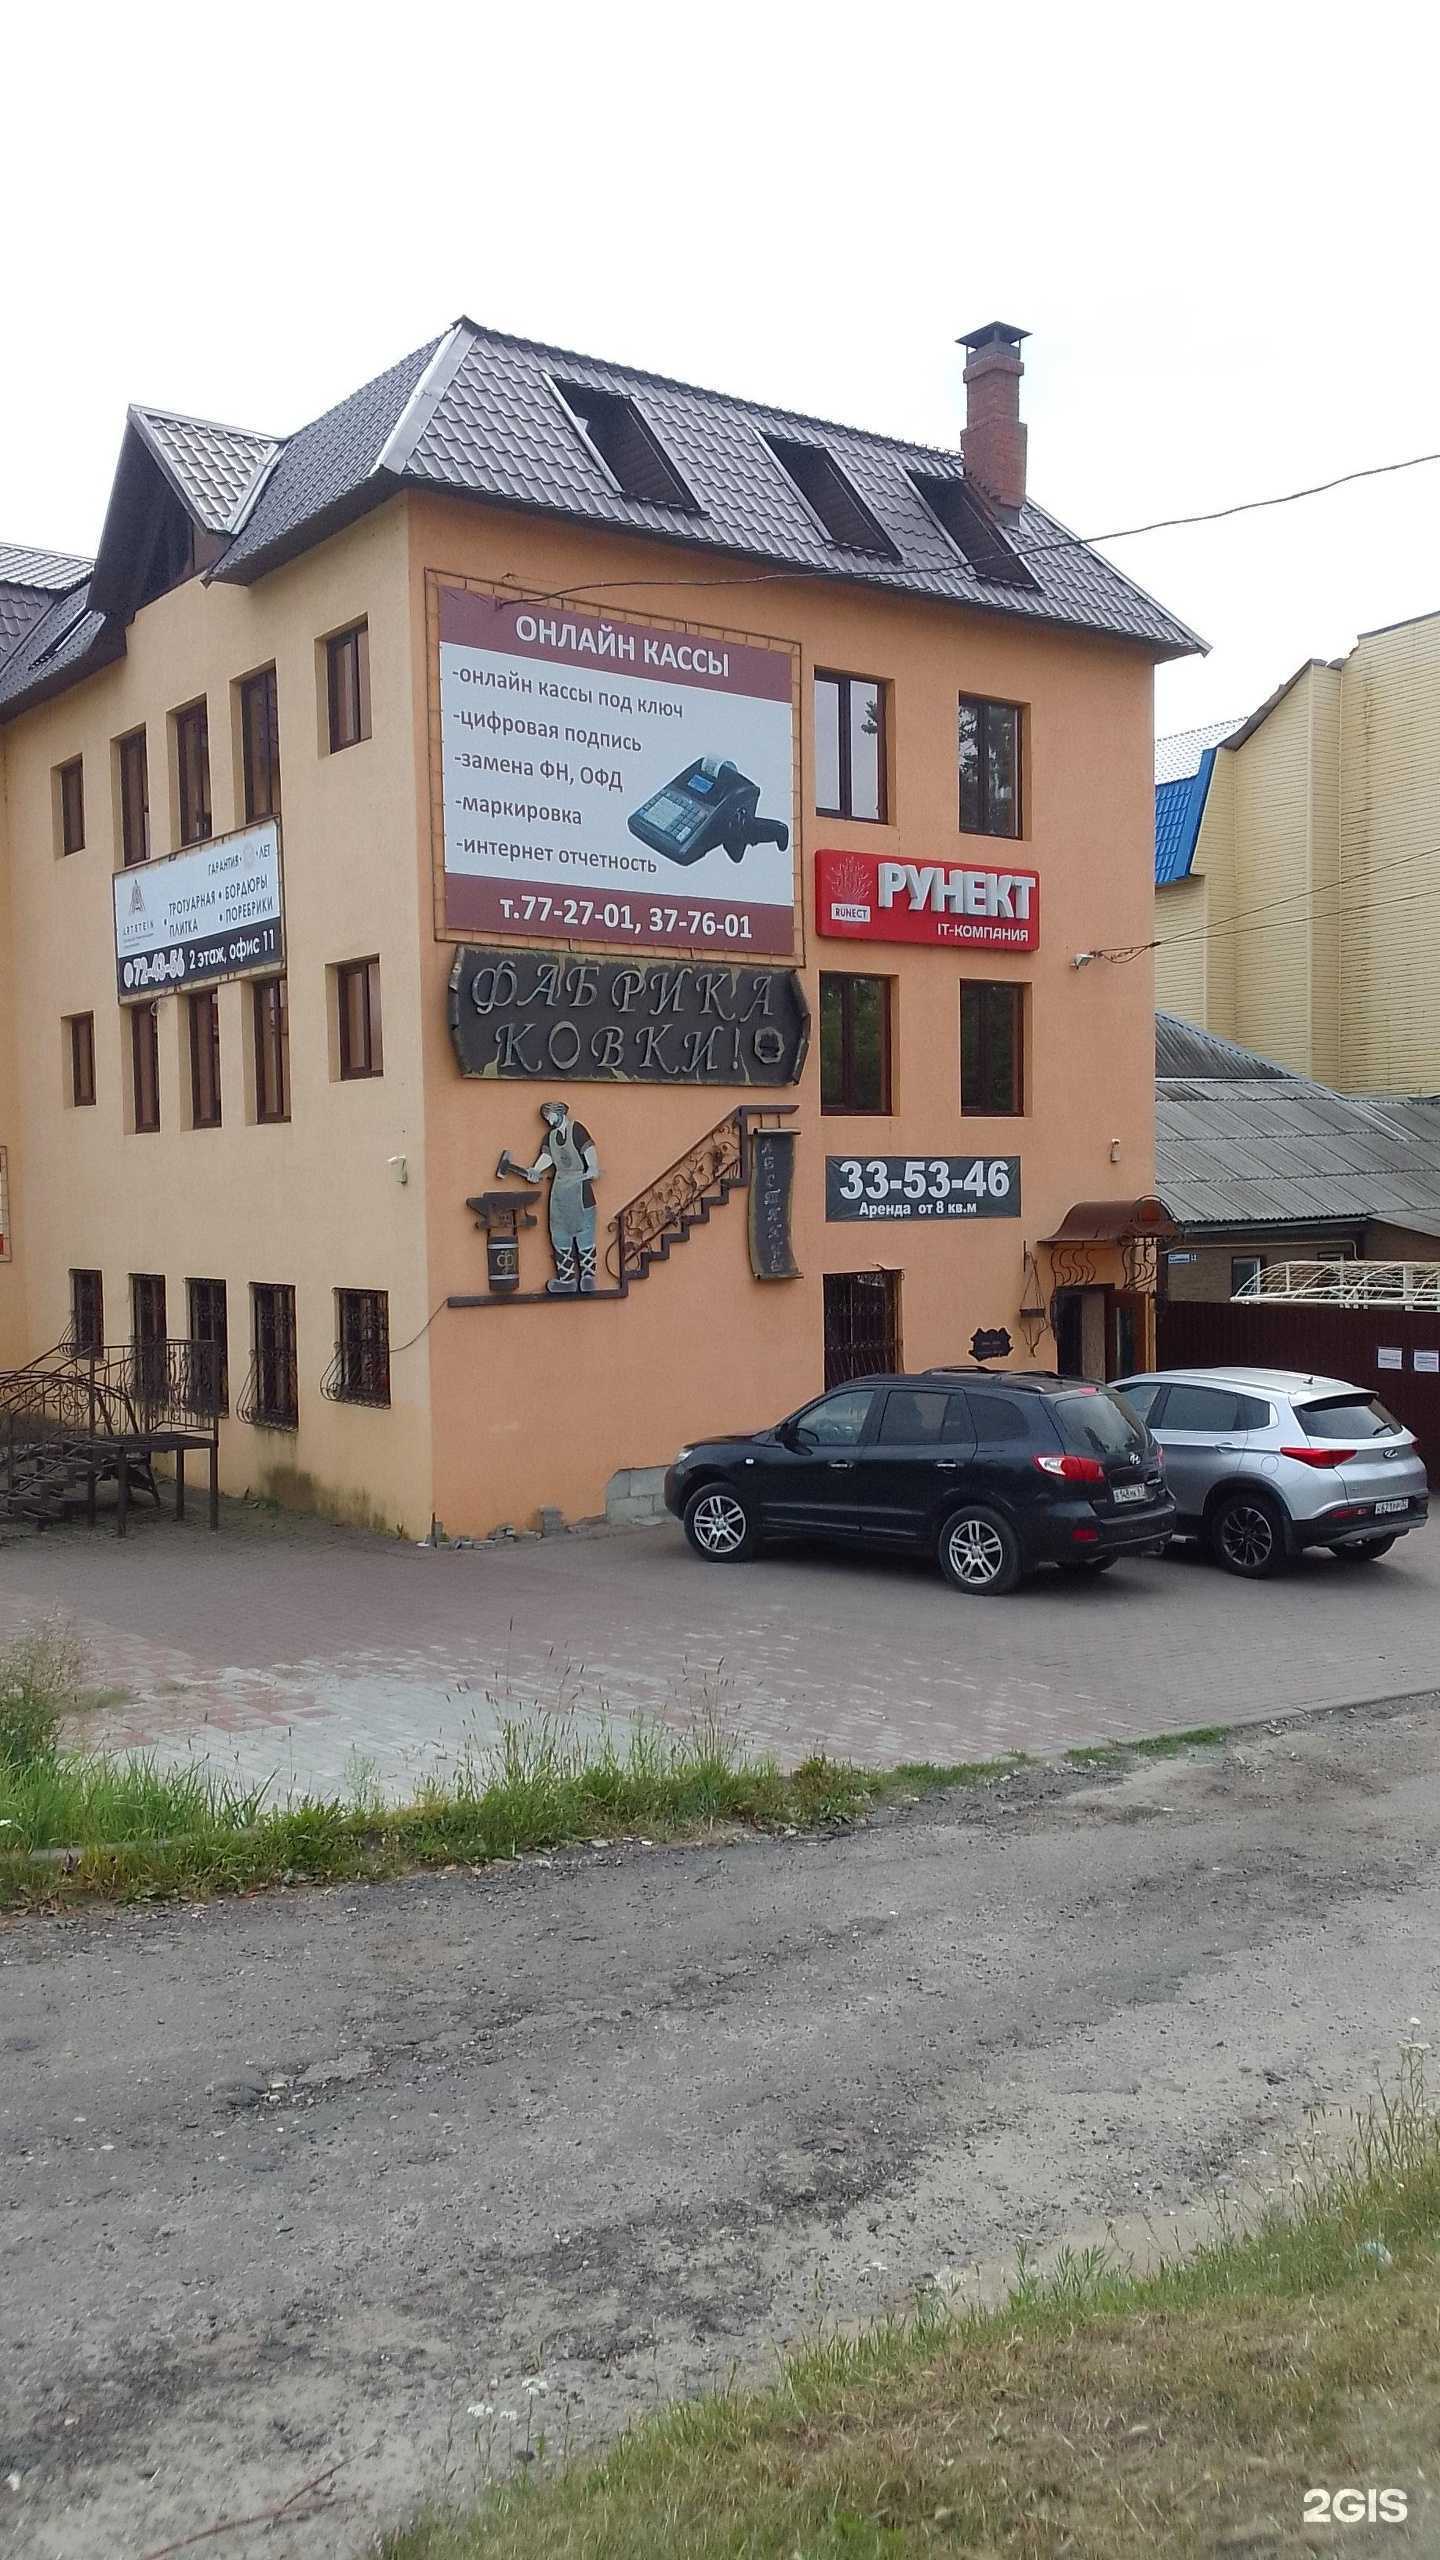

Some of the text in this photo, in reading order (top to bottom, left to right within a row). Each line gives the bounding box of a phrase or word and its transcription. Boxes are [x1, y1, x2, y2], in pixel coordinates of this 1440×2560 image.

[516, 614, 730, 677] ОНЛАЙН КАССЫ
[452, 668, 683, 718] -онлайн кассы под ключ
[453, 710, 642, 752] -цифровая подпись
[454, 754, 533, 777] -замена
[580, 766, 623, 792] ОФД
[455, 797, 582, 825] -маркировка
[456, 837, 657, 873] -интернет отчетность
[169, 874, 268, 916] ТРОТУАРНАЯ БОРДЮРЫ
[878, 862, 1036, 919] РУНЕКТ
[169, 896, 273, 937] ПЛИТКА ПОРЕБРИКИ
[649, 907, 752, 938] 37-76-01
[835, 907, 867, 919] RUNECT
[937, 923, 1029, 942] IT-КОМПАНИЯ
[189, 928, 275, 970] 2 этаж, офис 11
[471, 960, 775, 1023] ФАБРИКА
[839, 1160, 1010, 1200] 33-53-46
[859, 1201, 977, 1217] Аренда от 8 кв.м
